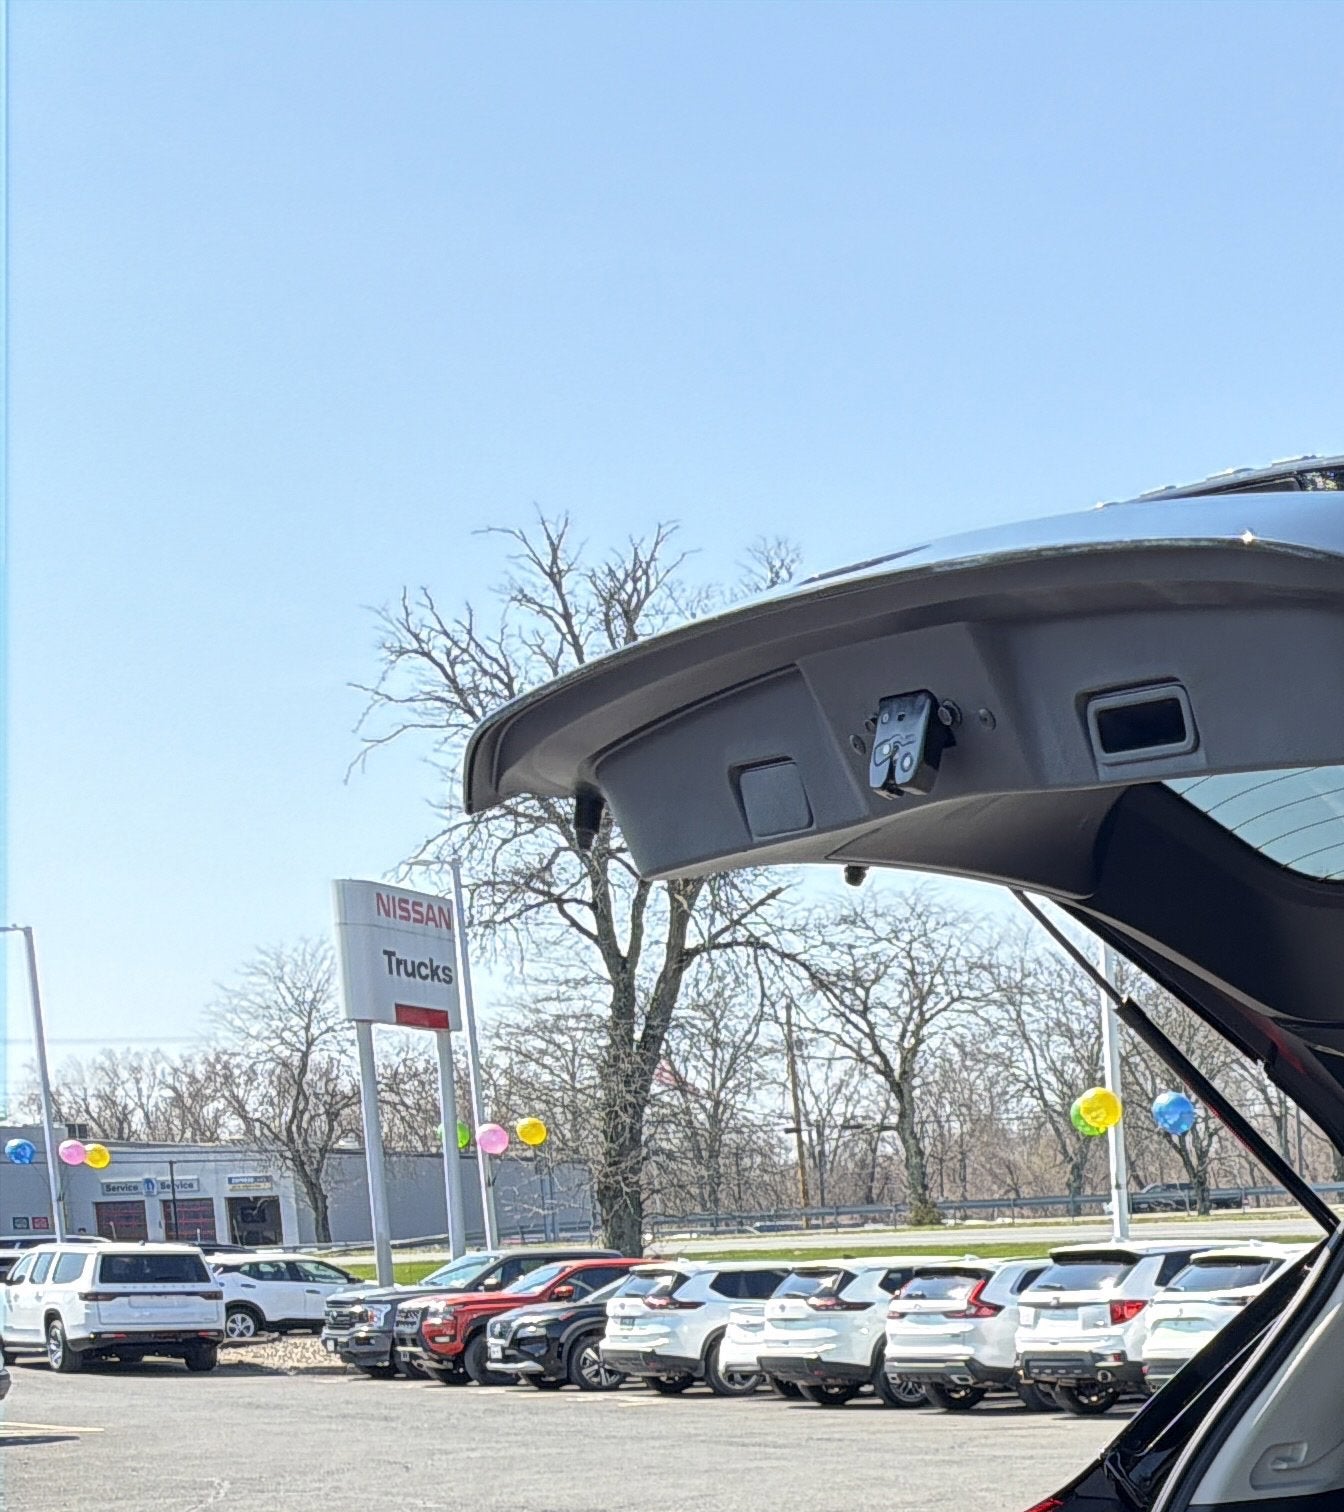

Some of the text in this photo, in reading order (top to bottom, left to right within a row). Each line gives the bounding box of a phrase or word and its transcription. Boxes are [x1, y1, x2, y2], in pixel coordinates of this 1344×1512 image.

[375, 892, 452, 931] NISSAN
[382, 949, 453, 985] Trucks
[105, 1181, 194, 1192] Service Sevice
